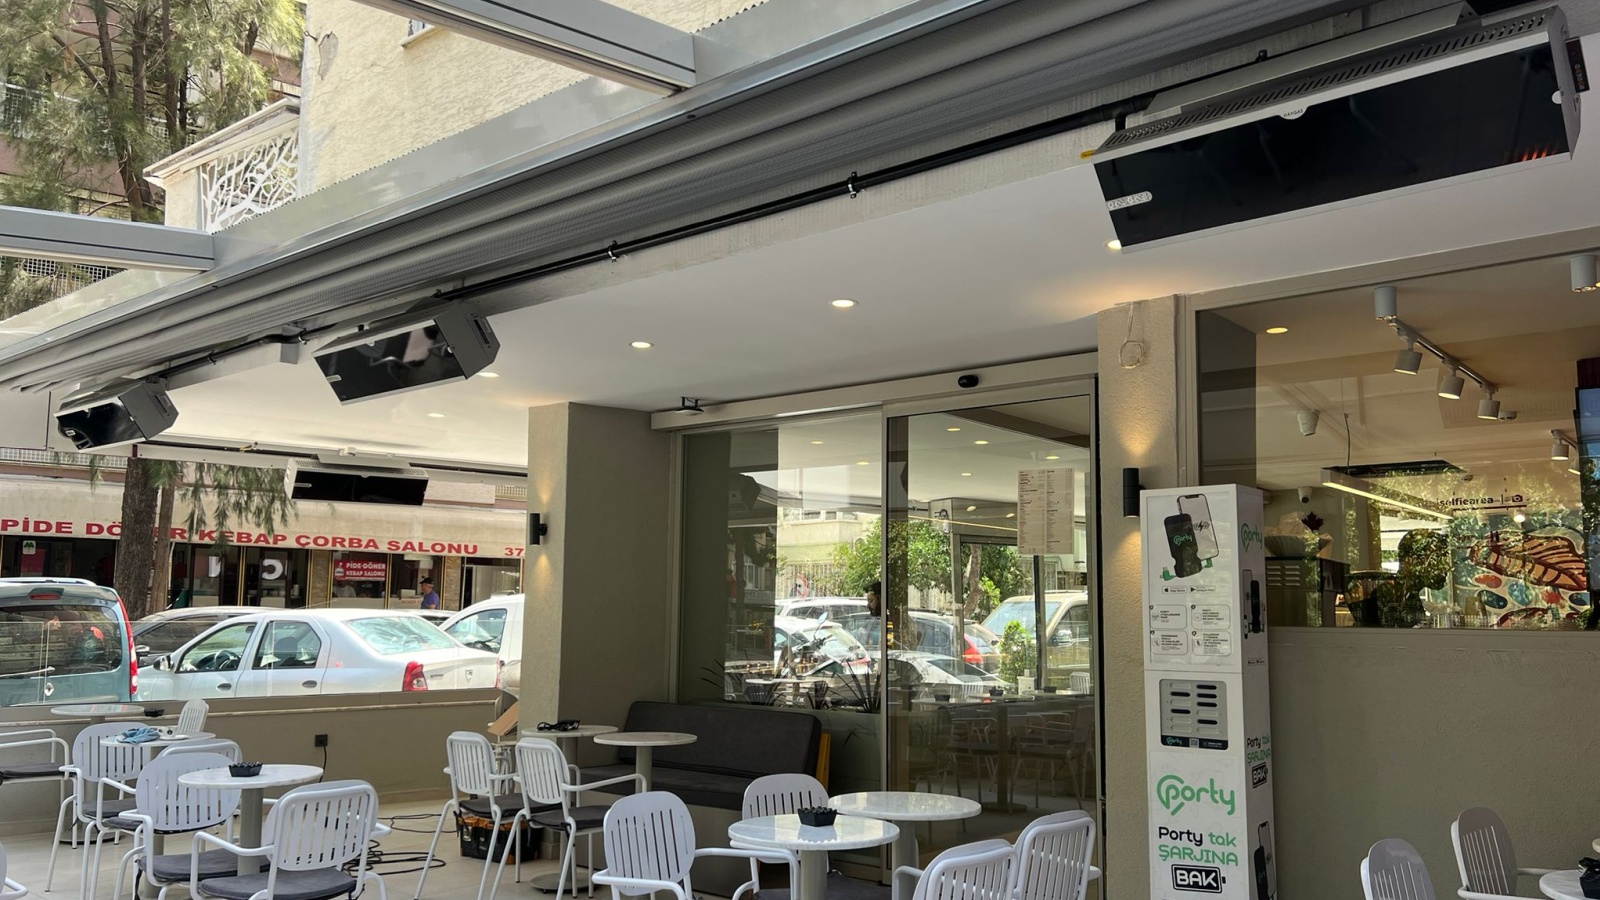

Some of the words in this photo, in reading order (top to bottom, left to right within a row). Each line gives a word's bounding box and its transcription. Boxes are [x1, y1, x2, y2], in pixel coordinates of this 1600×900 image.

[1, 517, 73, 534] PİDE
[86, 521, 188, 540] DÖR
[295, 535, 379, 549] ÇORBA
[387, 540, 478, 555] SALONU
[1158, 826, 1203, 847] Porty
[1208, 832, 1237, 847] tak
[1158, 844, 1239, 867] ŞARJINA
[1176, 870, 1217, 888] BAK
